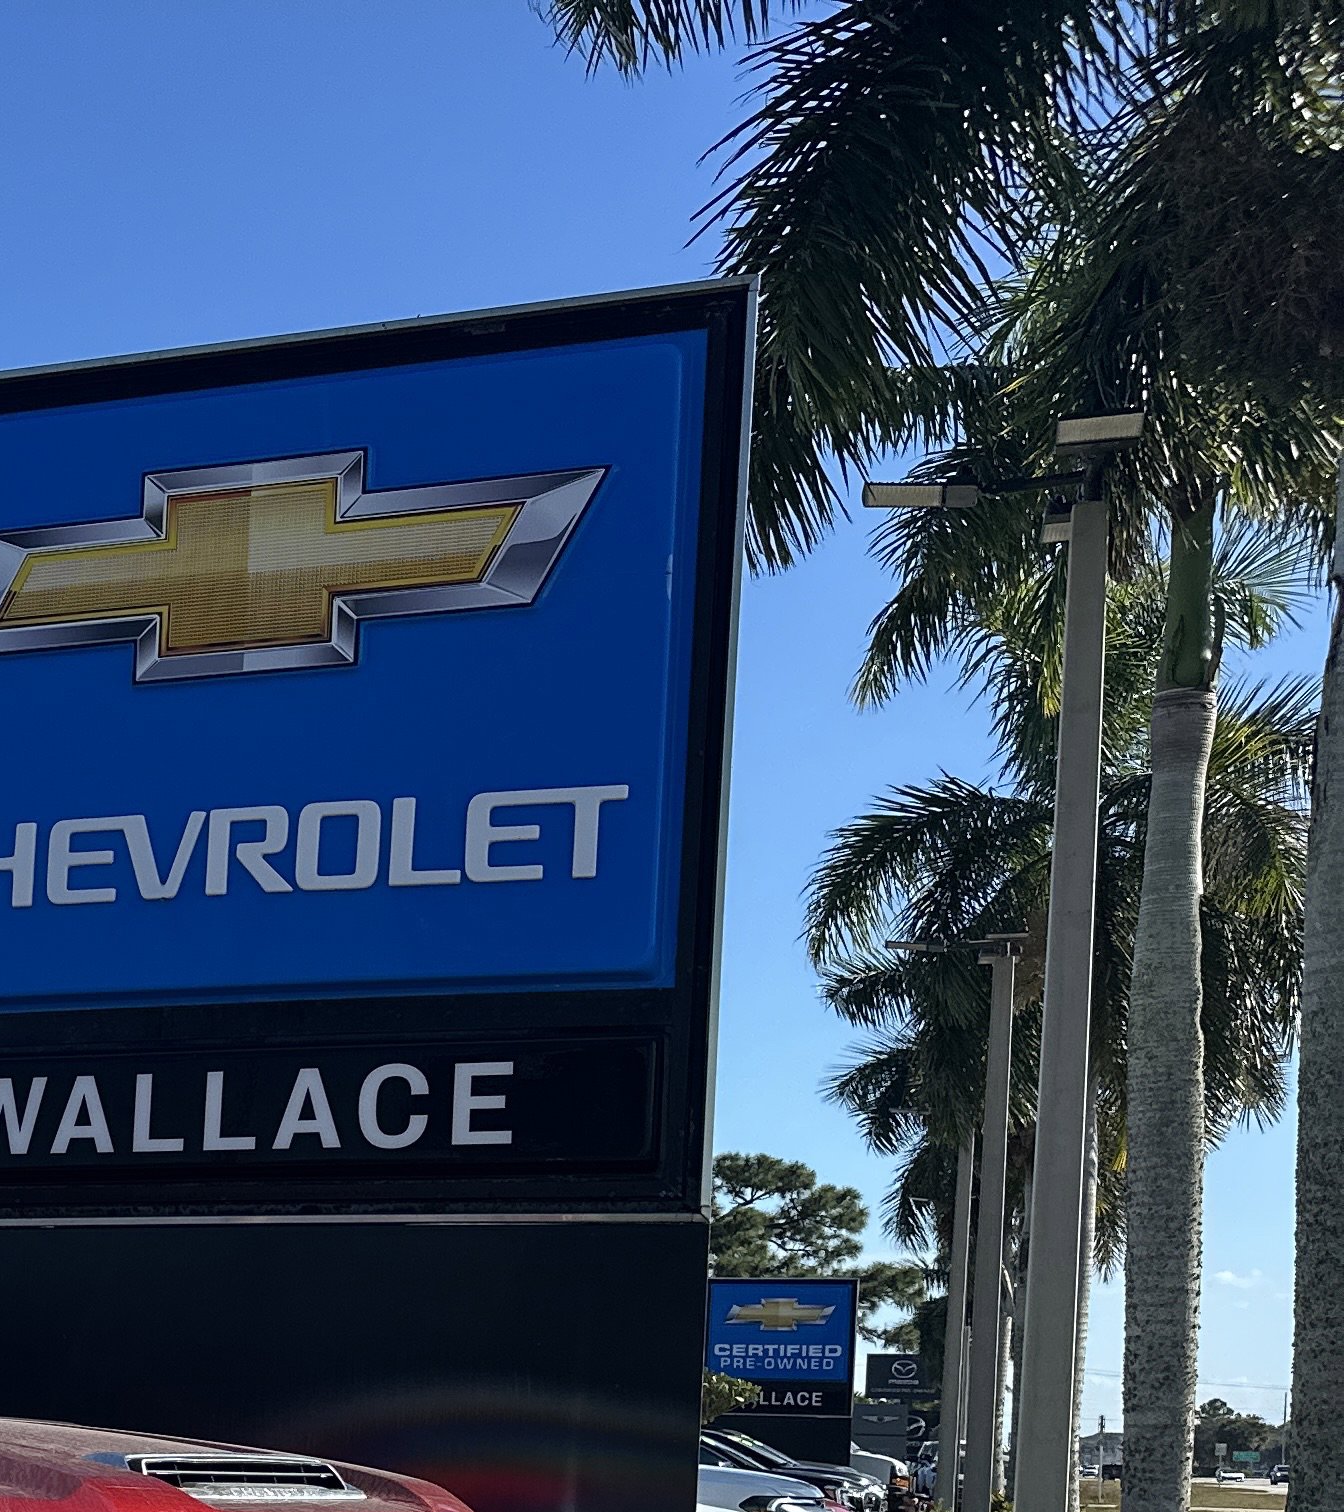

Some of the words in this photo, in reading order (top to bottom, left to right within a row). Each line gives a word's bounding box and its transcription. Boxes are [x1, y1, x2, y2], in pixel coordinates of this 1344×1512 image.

[714, 1343, 842, 1357] CERTIFIED
[720, 1357, 834, 1370] PRE-OWNED
[759, 1391, 823, 1406] LLACE
